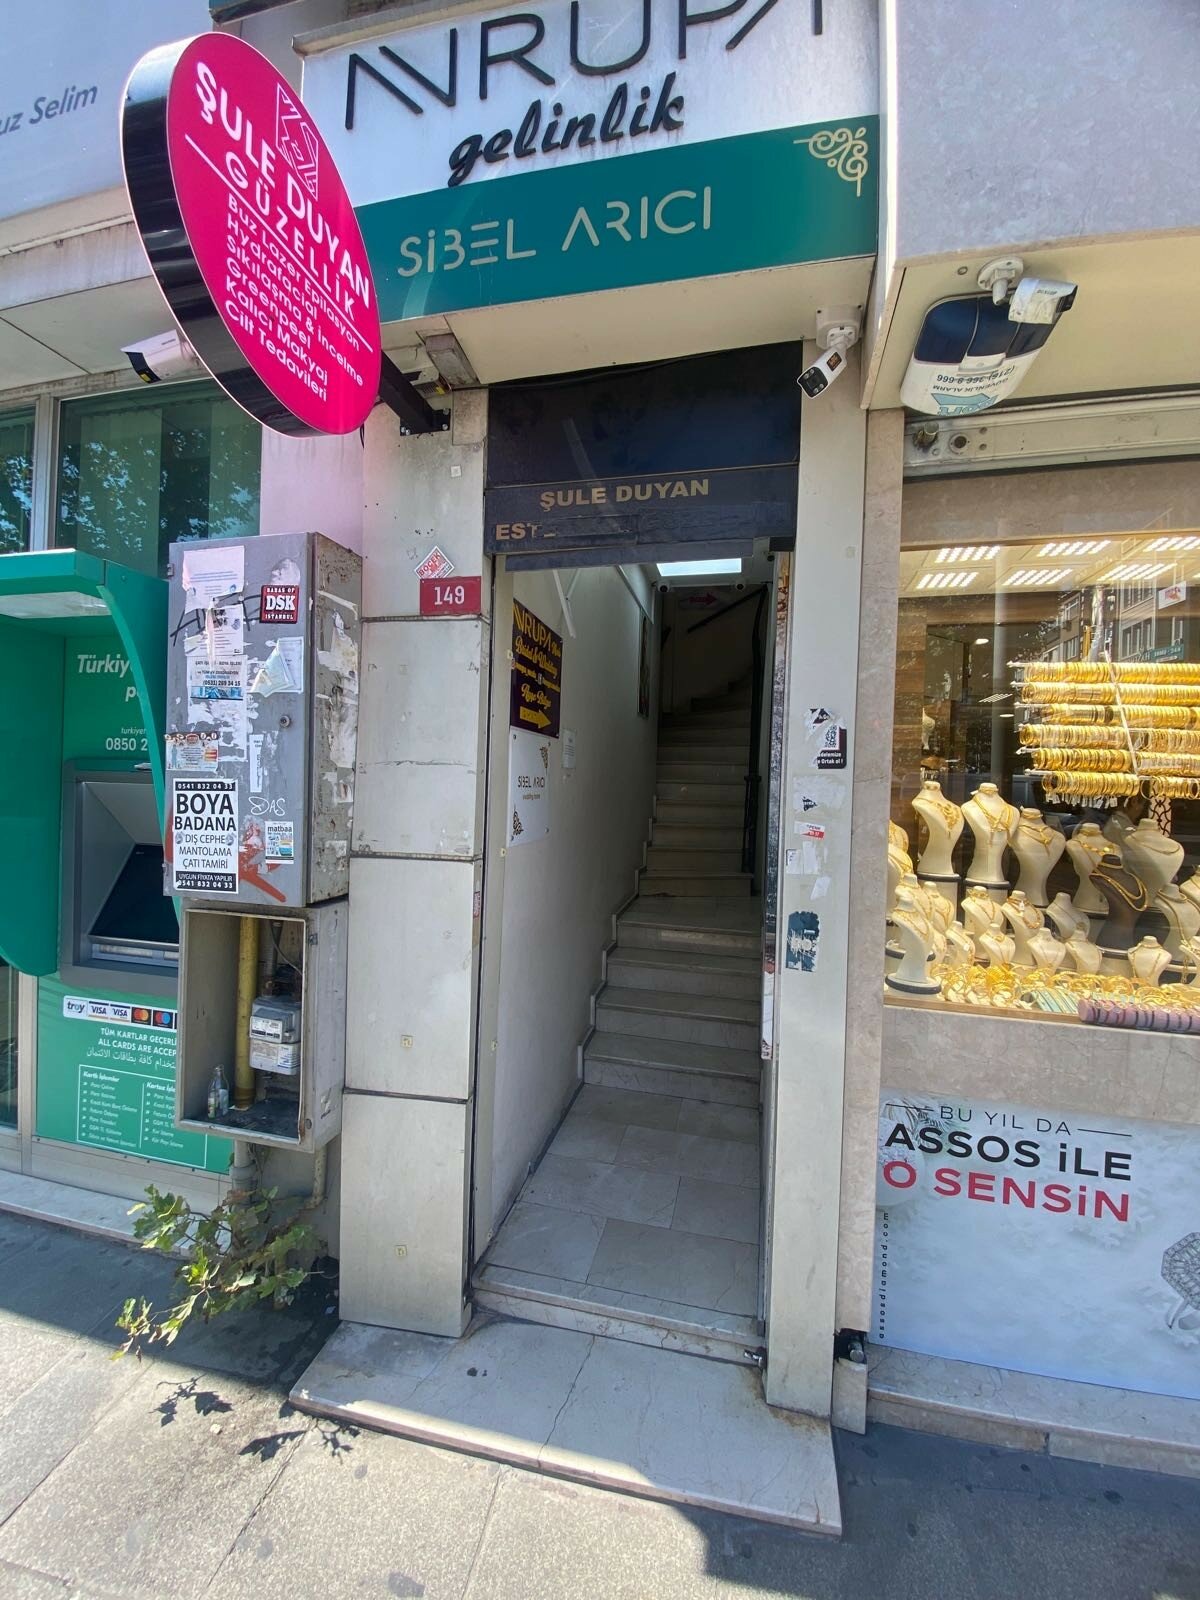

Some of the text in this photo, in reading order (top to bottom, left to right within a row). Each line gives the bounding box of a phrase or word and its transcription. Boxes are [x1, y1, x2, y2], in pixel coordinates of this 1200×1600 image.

[29, 85, 98, 125] Selim
[447, 72, 687, 187] gelinlik
[195, 62, 370, 308] ŞULE DUYAN
[562, 186, 712, 252] ARICI
[225, 151, 355, 321] GÜZELLİK
[227, 213, 318, 320] Hydrafacial
[228, 193, 360, 352] Buz Lazer Epilasyon
[226, 257, 311, 349] Greenpeel
[227, 234, 364, 386] Sıkılaşma & incelme
[226, 277, 328, 386] Kalıcı Makyaj
[225, 301, 327, 402] Cilt Tedavileri
[540, 479, 709, 512] ŞULE DUYAN
[265, 595, 296, 611] DSK
[434, 585, 465, 606] 149
[77, 653, 133, 678] Türkiy
[125, 686, 139, 702] p
[105, 738, 137, 751] 0850
[176, 793, 234, 815] BOYA
[174, 816, 237, 832] BADANA
[267, 825, 293, 833] matbaa
[178, 846, 233, 857] MANTOLAMA
[185, 833, 226, 845] DIŞ CEPHE
[182, 857, 229, 869] ÇATI TAMİRİ
[67, 1001, 85, 1013] troy
[91, 1005, 107, 1015] VISA
[113, 1008, 128, 1017] VISA
[98, 1038, 111, 1047] ALL
[112, 1040, 136, 1051] CARDS
[138, 1044, 152, 1053] ARE
[100, 1027, 116, 1037] TÜM
[116, 1030, 148, 1041] KARTLAR
[940, 1105, 1071, 1136] BU YIL DA
[884, 1122, 1041, 1168] ASSOS
[883, 1160, 917, 1189] O
